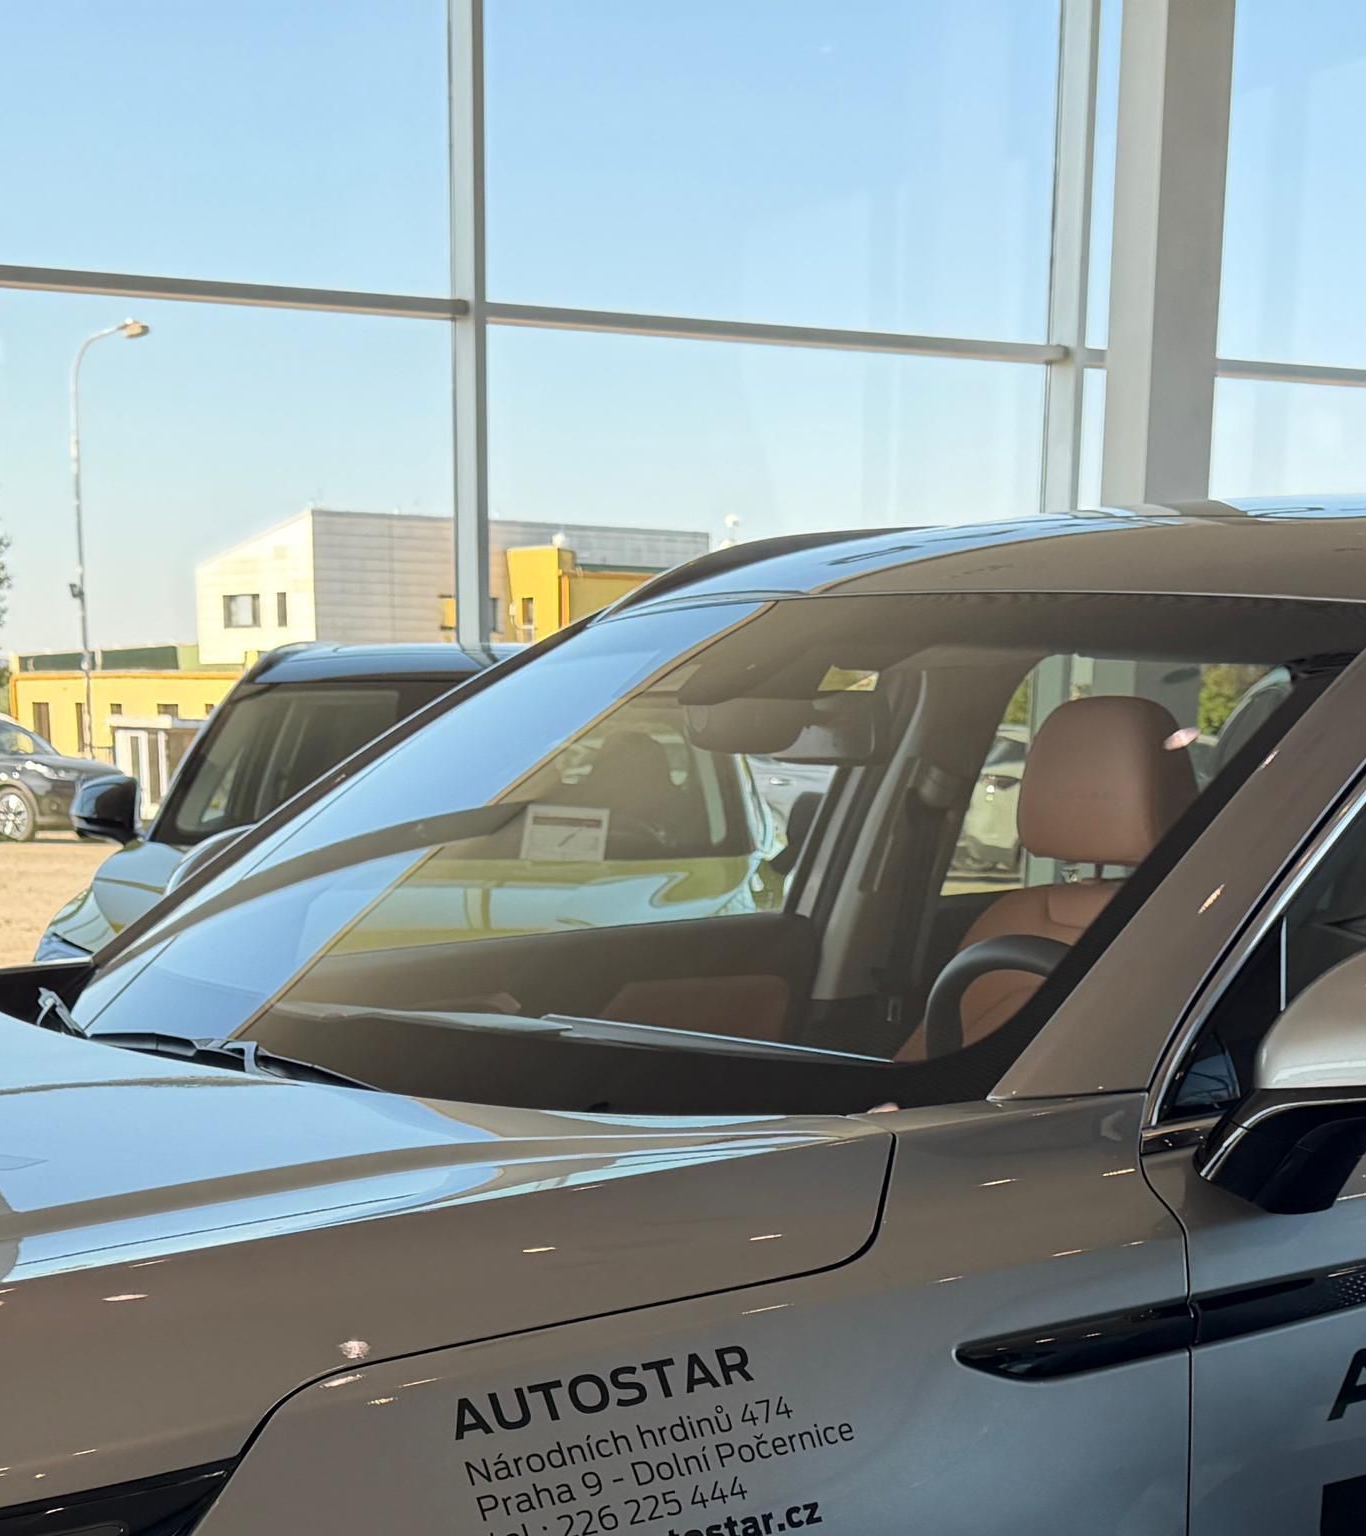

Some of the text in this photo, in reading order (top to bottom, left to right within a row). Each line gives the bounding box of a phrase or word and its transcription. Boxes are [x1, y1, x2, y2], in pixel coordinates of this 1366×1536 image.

[454, 1344, 755, 1441] AUTOSTAR
[463, 1395, 794, 1487] Národních hrdinů 474
[476, 1480, 577, 1522] Praha
[581, 1470, 604, 1498] 9
[630, 1446, 712, 1488] Dolní
[717, 1419, 856, 1467] Počernice
[622, 1489, 684, 1527] 225
[689, 1475, 749, 1511] 444
